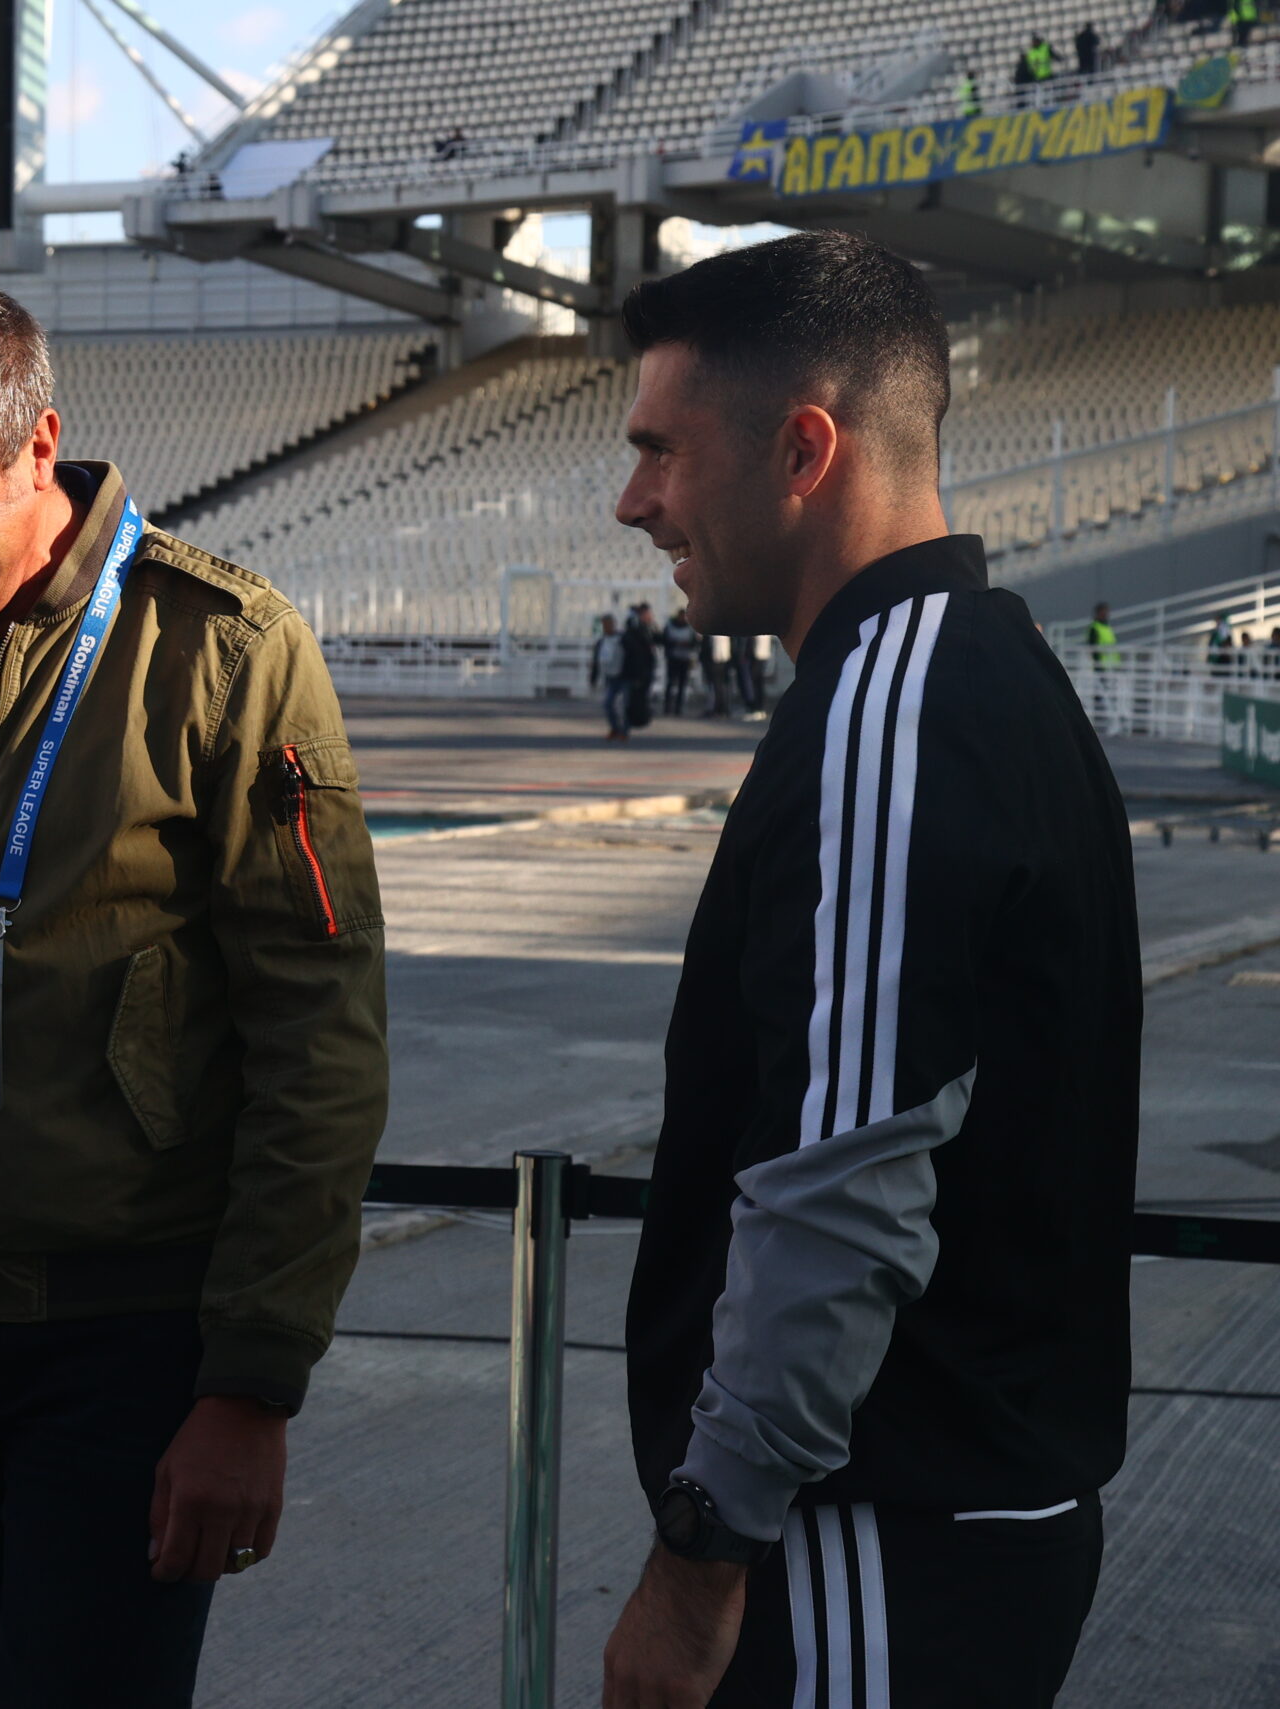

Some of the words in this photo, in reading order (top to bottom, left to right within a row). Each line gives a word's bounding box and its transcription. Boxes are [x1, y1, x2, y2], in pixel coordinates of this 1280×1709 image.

[783, 126, 936, 195] ΑΓΑΠΩ
[955, 86, 1168, 173] ΣΗΜΑΙΝΕΙ
[111, 520, 137, 563] SUPER
[90, 561, 122, 620] LEAGUE
[52, 633, 96, 723] Stoiximan
[28, 739, 55, 790] SUPER
[9, 792, 37, 857] LEAGUE
